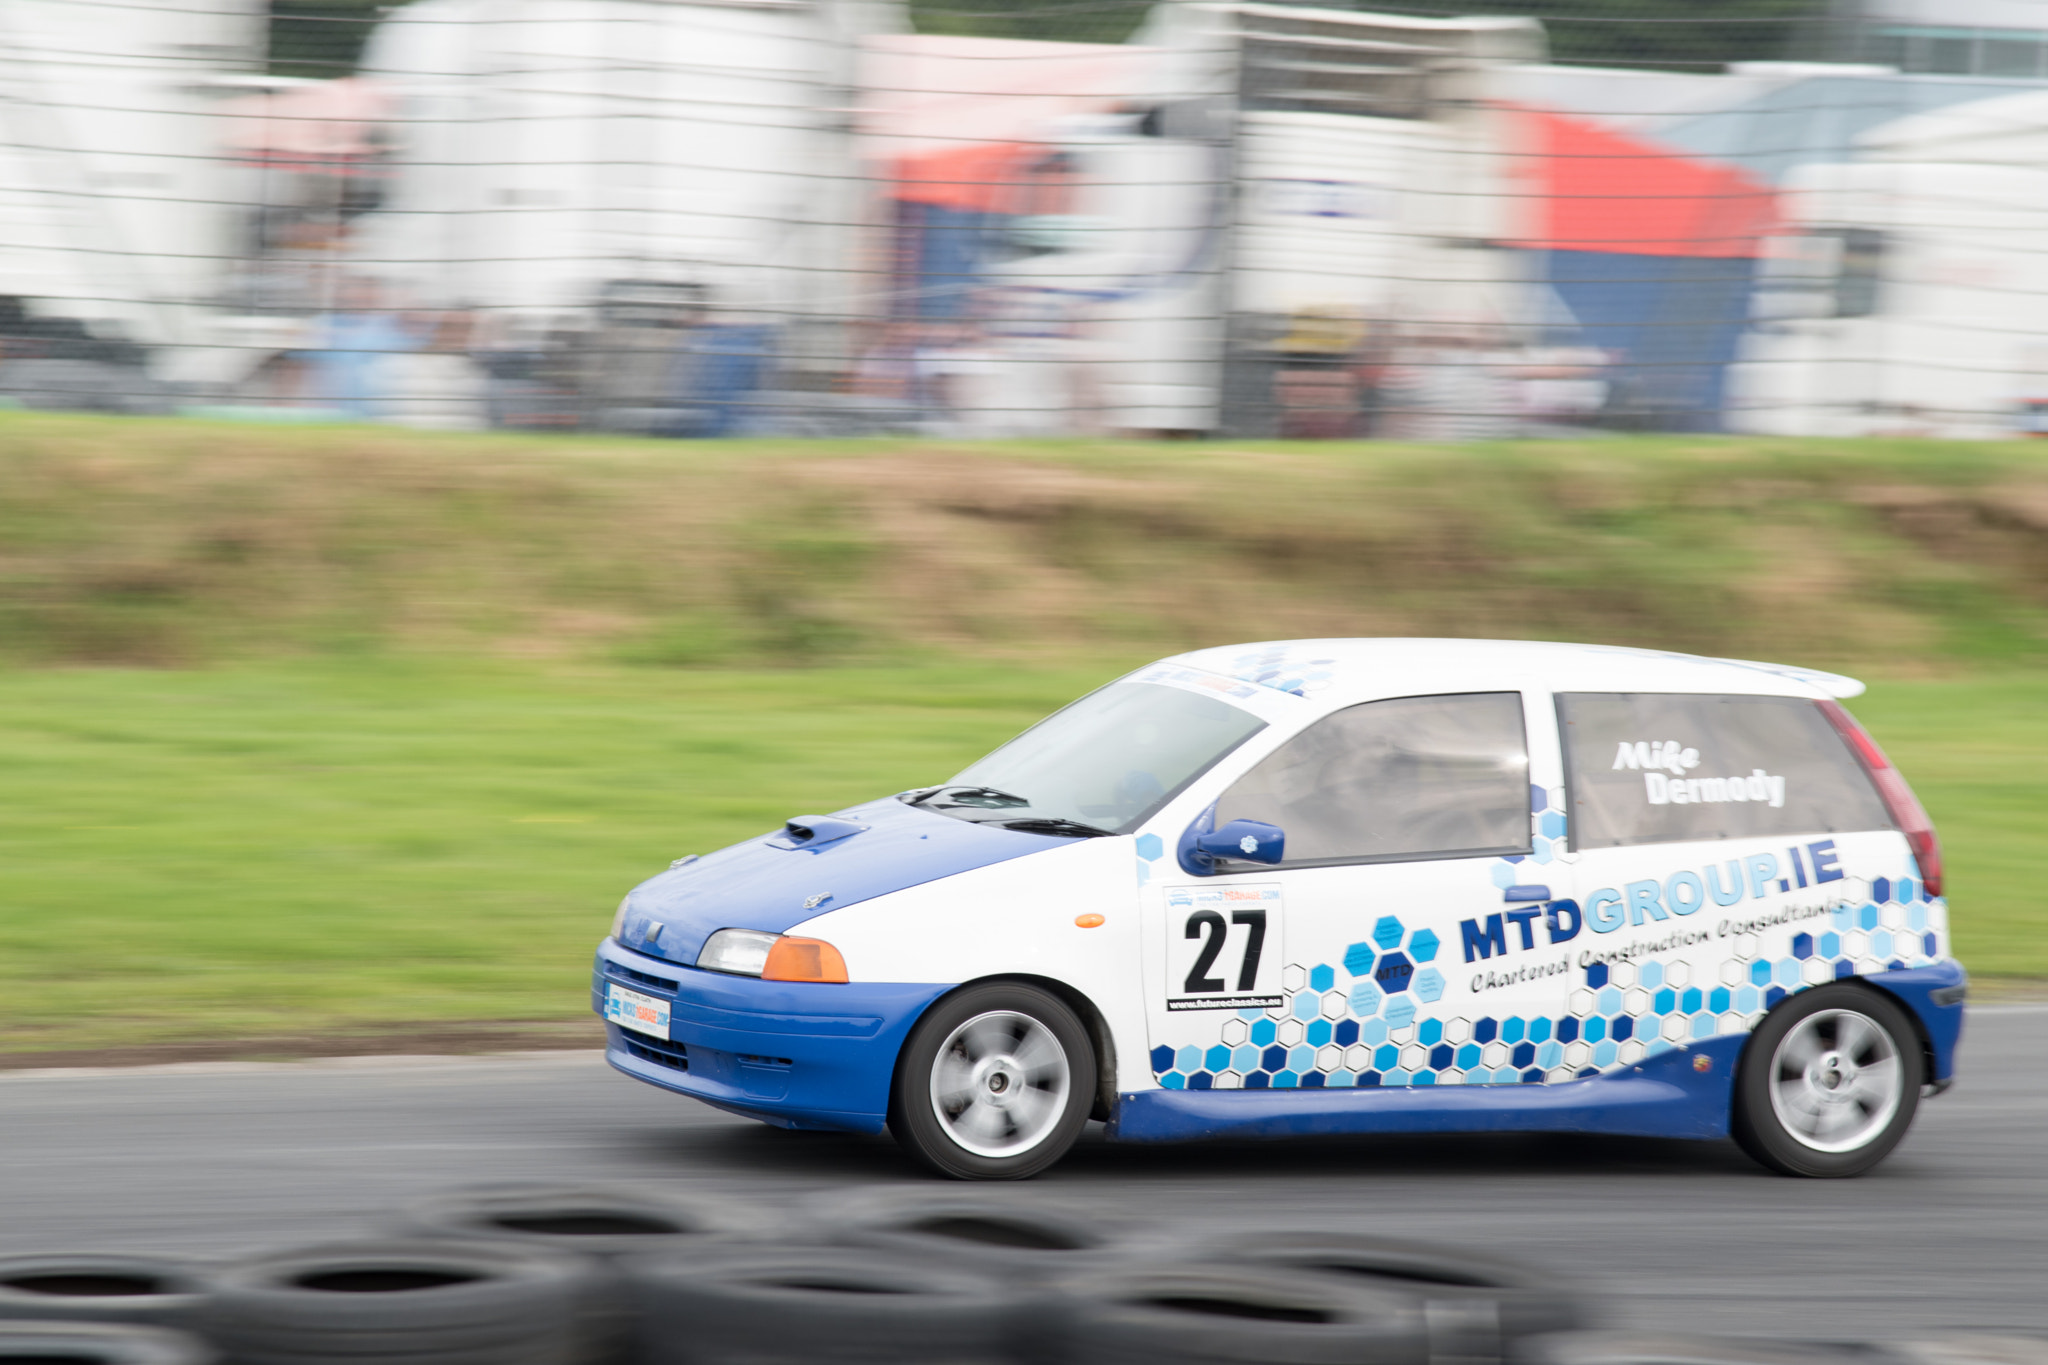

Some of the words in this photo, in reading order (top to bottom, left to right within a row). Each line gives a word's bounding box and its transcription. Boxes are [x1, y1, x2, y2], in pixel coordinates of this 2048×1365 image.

[1611, 740, 1700, 776] Mike
[1644, 769, 1785, 808] Dermody
[1460, 839, 1844, 963] MTDGROUP.IE
[1184, 909, 1266, 993] 27
[1471, 953, 1568, 993] Chartered
[1579, 929, 1709, 969] Construction
[1717, 898, 1845, 938] Consultants
[1376, 963, 1411, 981] MTD
[1169, 997, 1282, 1010] www.futureclassics.eu
